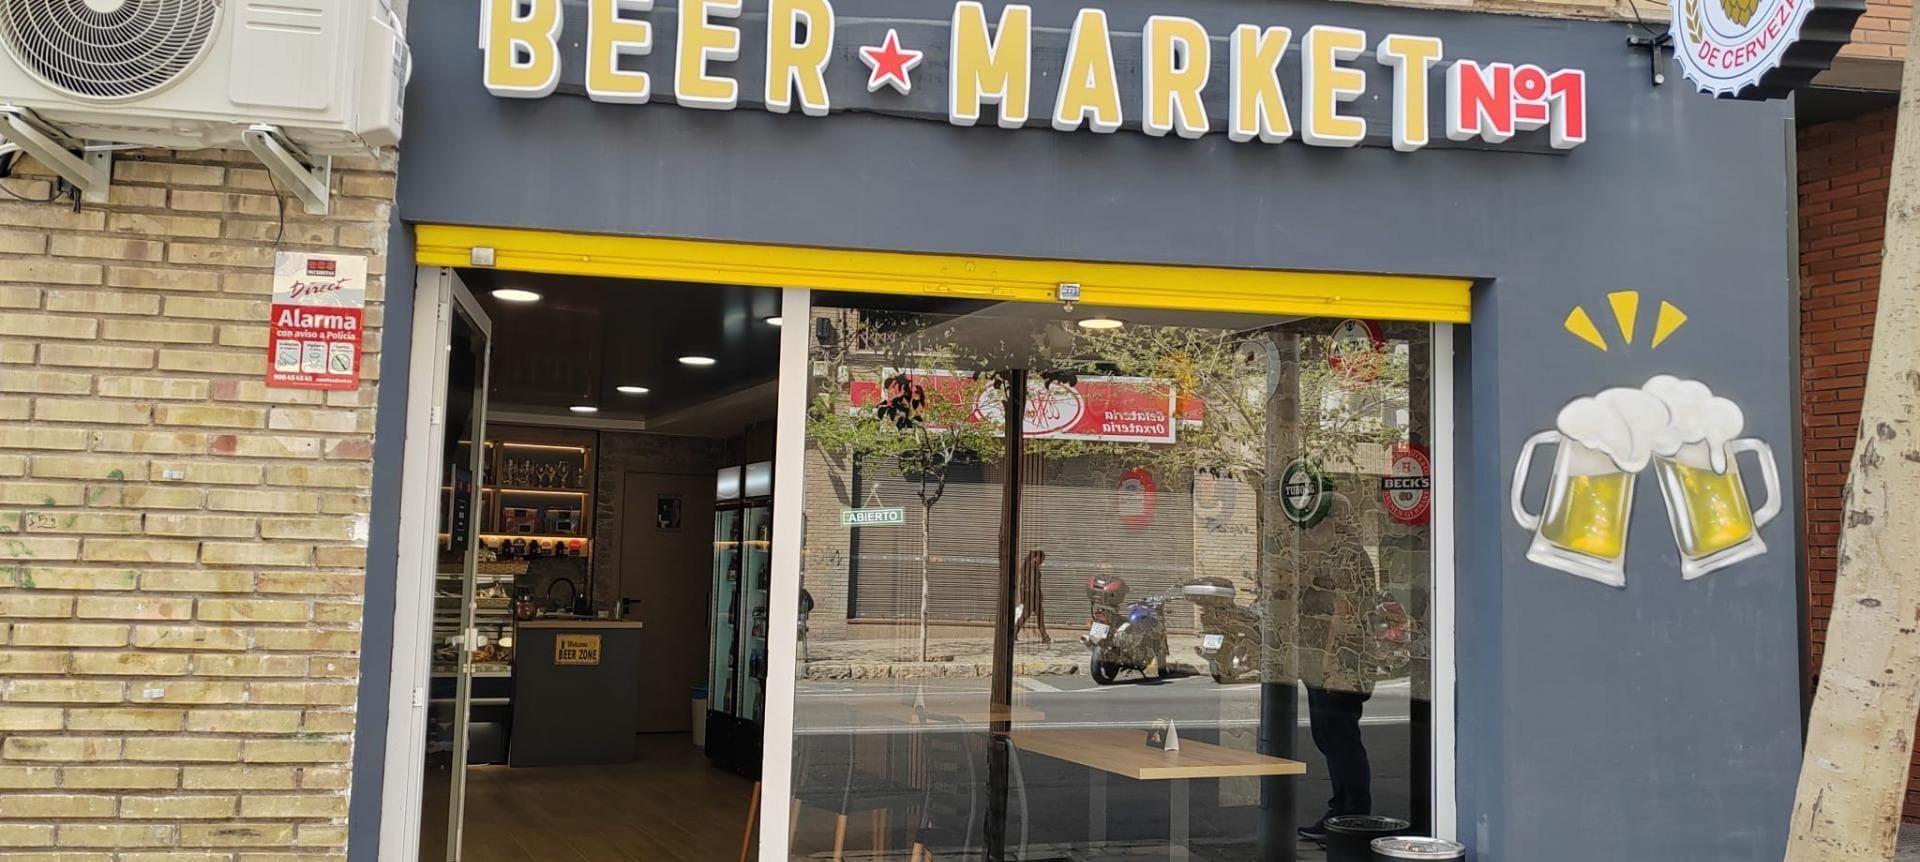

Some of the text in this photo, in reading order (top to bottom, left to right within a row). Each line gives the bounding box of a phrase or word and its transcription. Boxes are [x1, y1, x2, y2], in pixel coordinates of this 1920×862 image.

[483, 0, 835, 116] BEER
[1698, 40, 1720, 68] DE
[949, 1, 1442, 151] MARKET
[289, 278, 351, 298] Direct
[277, 309, 357, 331] Alarma
[294, 330, 318, 338] aviso
[1384, 478, 1430, 488] BECK'S
[848, 511, 898, 522] ABIERTO
[559, 649, 597, 660] BEER ZONE
